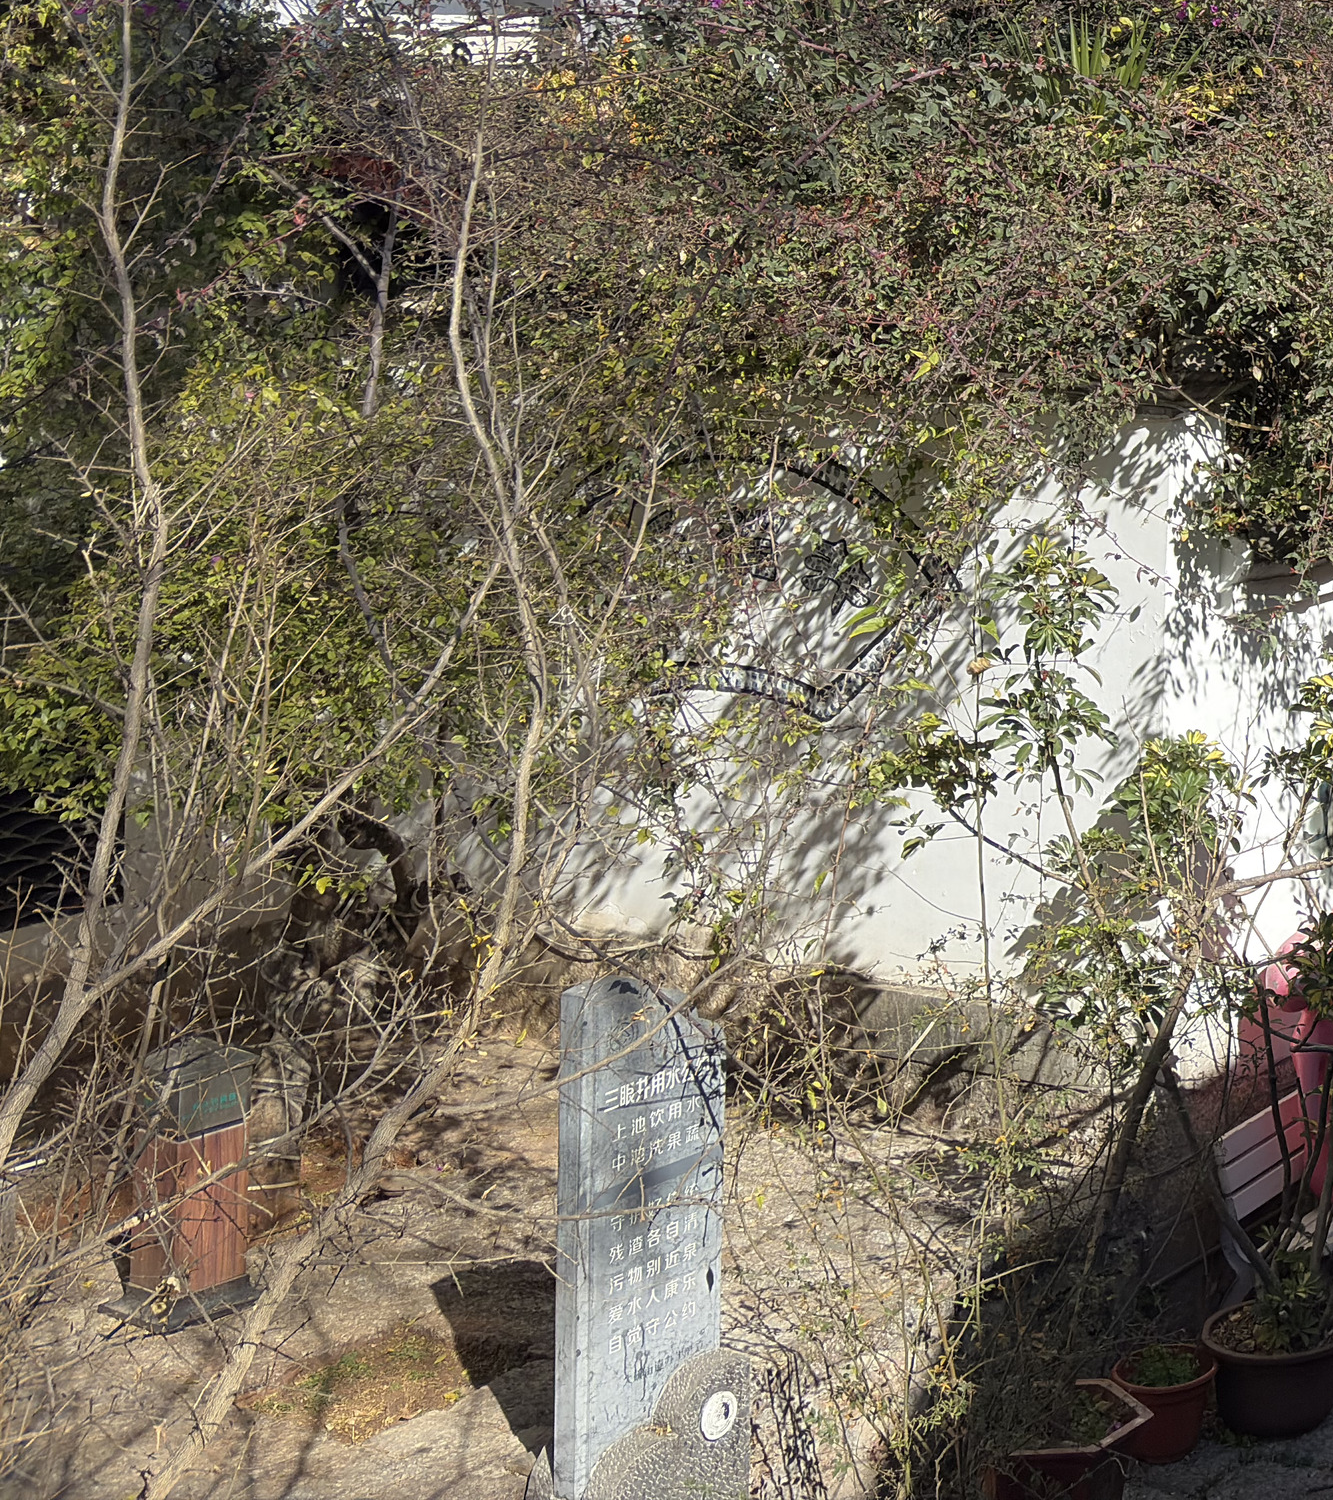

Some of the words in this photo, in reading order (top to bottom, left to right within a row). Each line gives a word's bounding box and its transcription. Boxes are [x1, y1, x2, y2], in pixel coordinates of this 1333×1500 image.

[611, 1095, 701, 1143] 上池饮用水
[611, 1123, 700, 1172] 中池洗果蔬
[609, 1211, 698, 1265] 残渣各自清
[609, 1242, 697, 1296] 污物别近泉
[608, 1270, 696, 1325] 爱水人康乐
[609, 1301, 696, 1355] 自觉守公约
